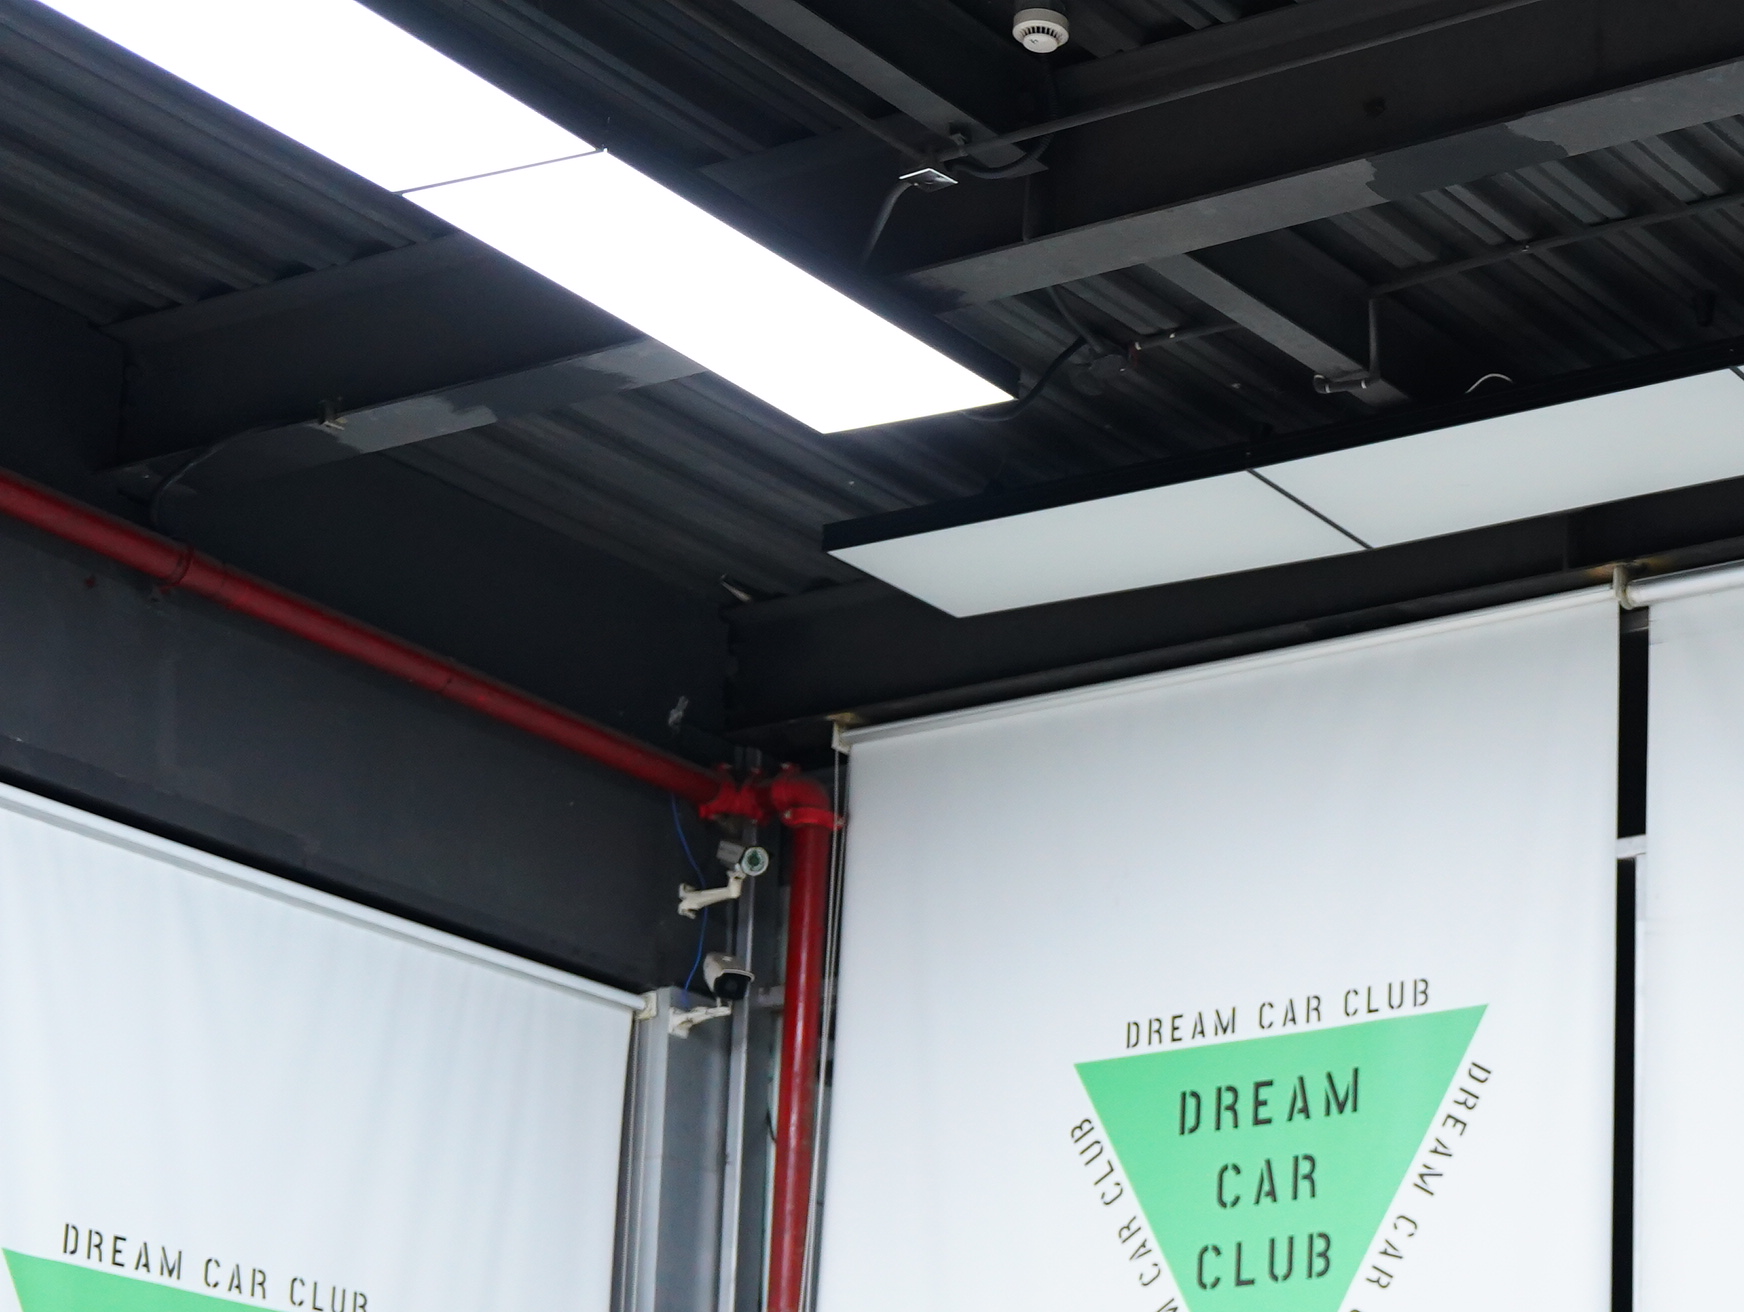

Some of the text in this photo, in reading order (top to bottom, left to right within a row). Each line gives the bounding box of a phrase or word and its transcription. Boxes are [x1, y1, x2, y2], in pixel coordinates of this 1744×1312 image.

[1126, 978, 1429, 1049] DREAM CAR CLUB
[1179, 1067, 1359, 1136] DREAM
[1413, 1061, 1492, 1196] DREAM
[1070, 1118, 1124, 1206] CLUB
[1216, 1154, 1316, 1209] CAR
[63, 1223, 183, 1281] DREAM
[203, 1258, 267, 1300] CAR
[1118, 1215, 1161, 1287] CAR
[1196, 1231, 1332, 1290] CLUB
[1366, 1214, 1418, 1289] CAR
